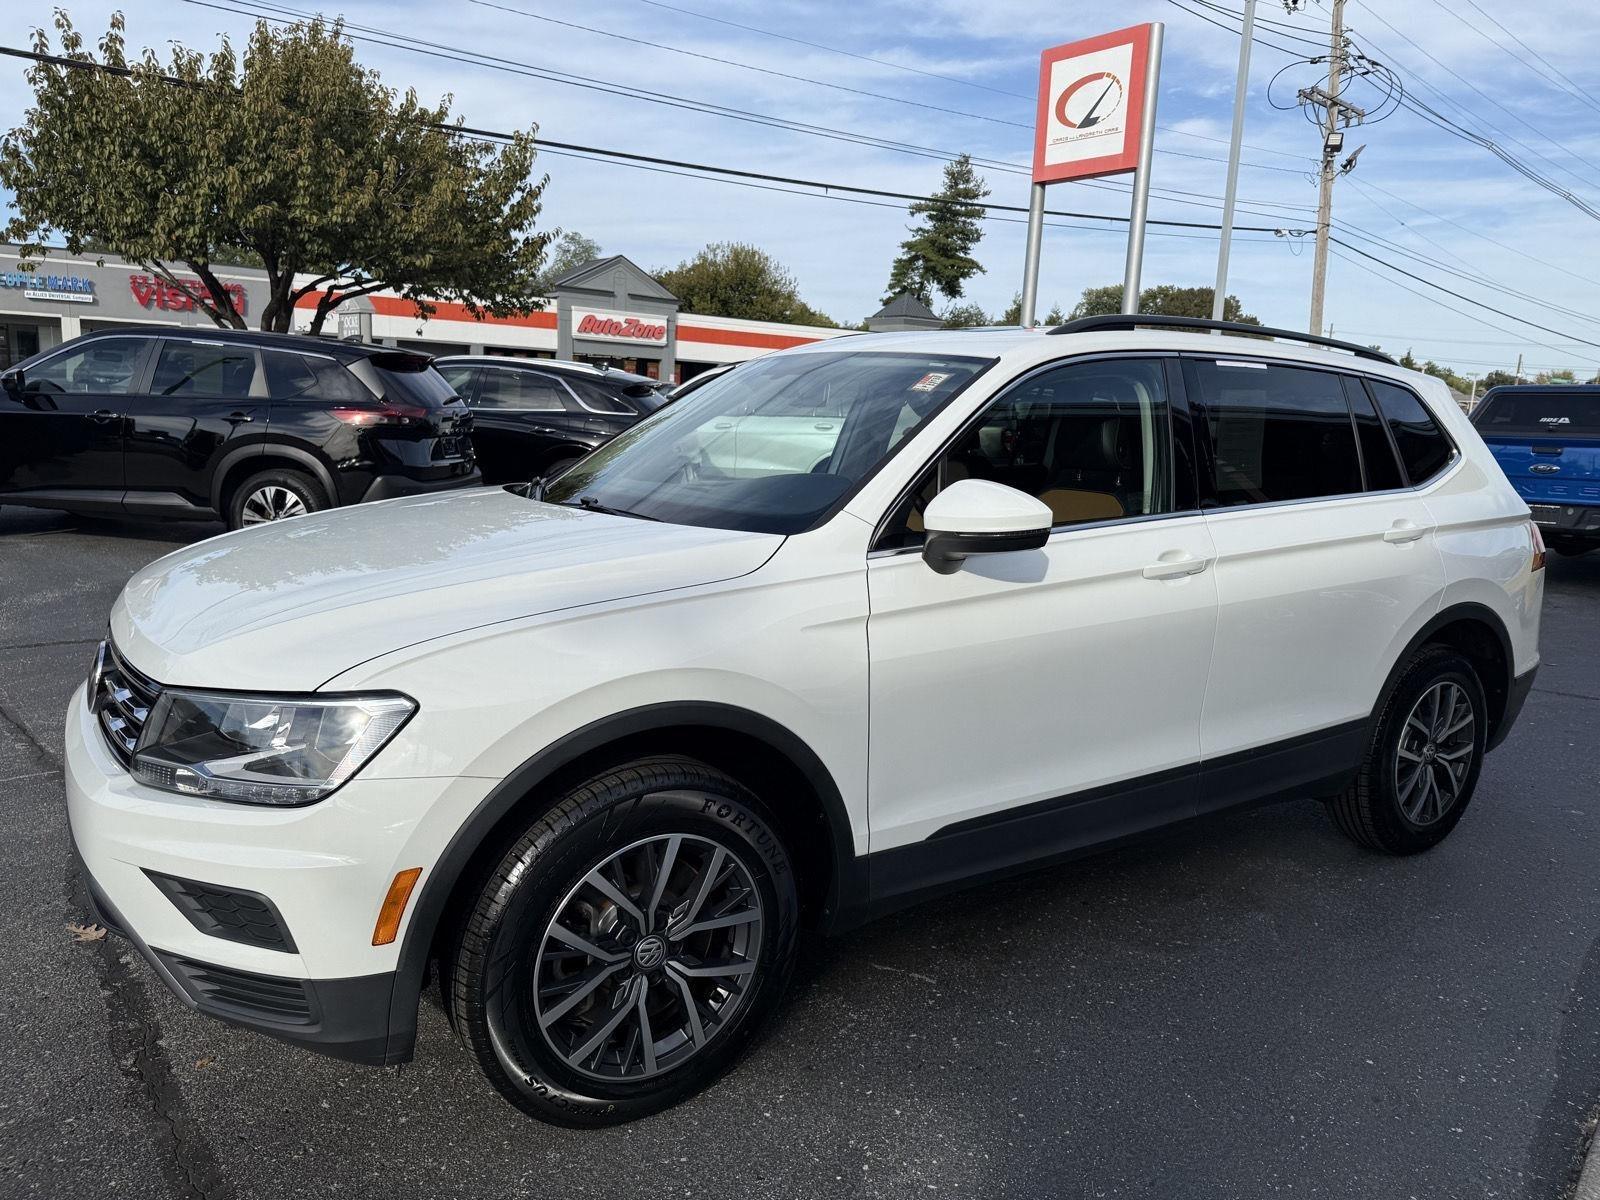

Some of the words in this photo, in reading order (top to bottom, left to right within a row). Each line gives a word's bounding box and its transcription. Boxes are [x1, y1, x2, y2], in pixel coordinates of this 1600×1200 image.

[47, 275, 91, 292] MARK
[577, 314, 665, 339] AutoZone
[699, 798, 787, 875] FORTUNE
